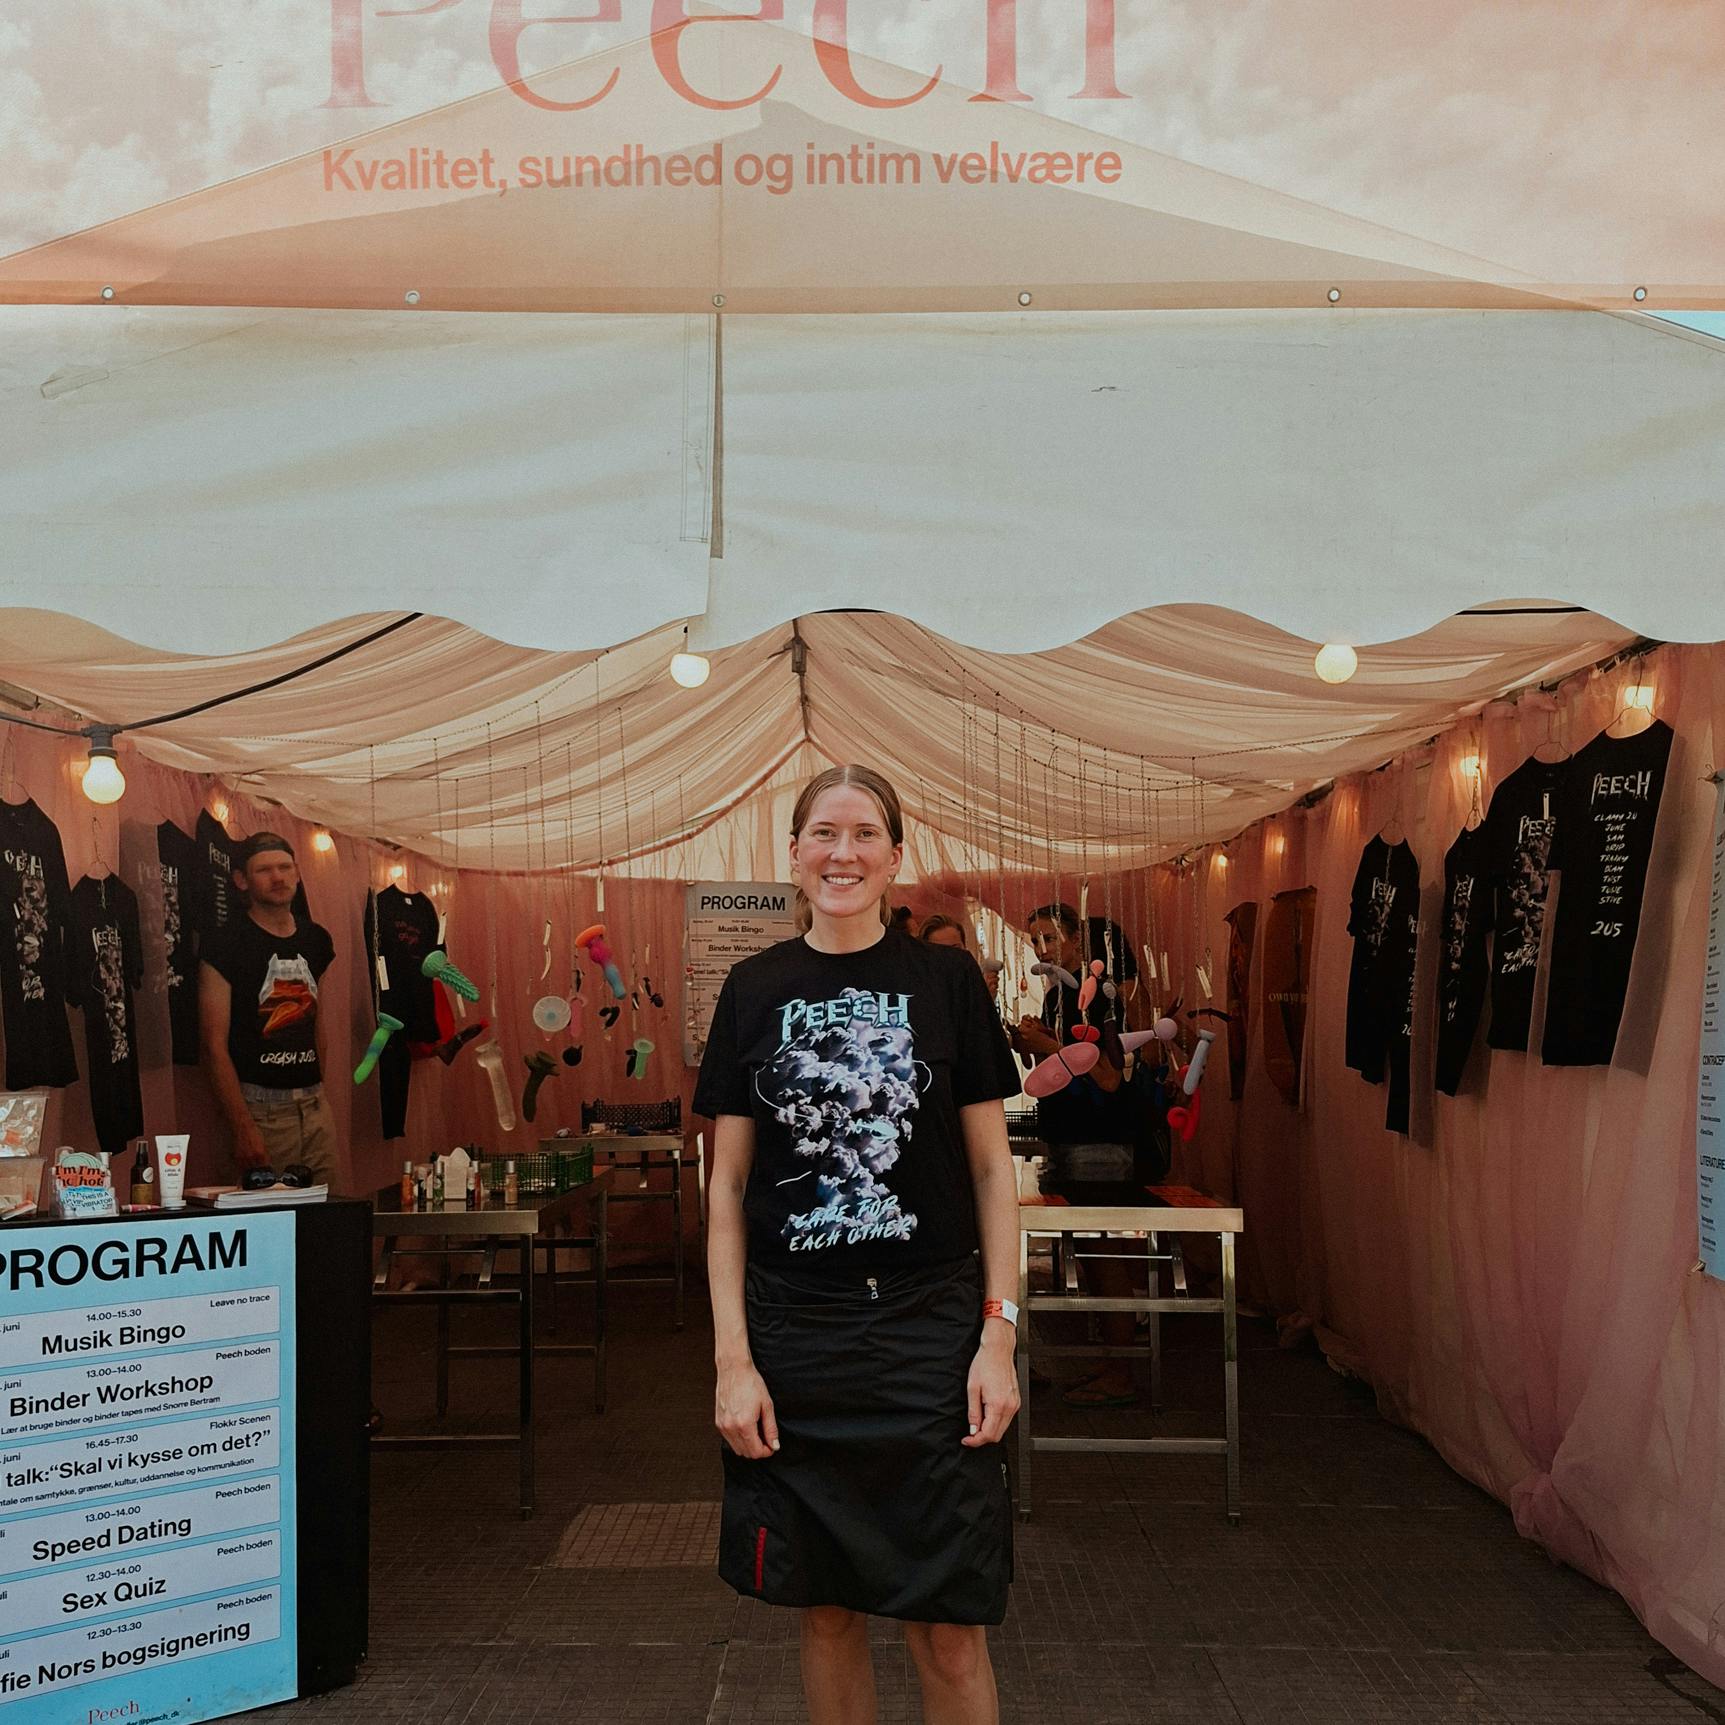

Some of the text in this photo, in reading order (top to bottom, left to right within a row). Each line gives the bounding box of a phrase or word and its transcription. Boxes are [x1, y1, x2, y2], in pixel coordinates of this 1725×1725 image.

[323, 141, 1124, 199] Kvalitet, sundhed og intim velvære
[701, 896, 786, 911] PROGRAM
[718, 926, 764, 935] Musik Bingo
[708, 944, 732, 952] Binder
[773, 991, 919, 1057] PEECH
[793, 1195, 902, 1230] CARE FOR
[789, 1215, 913, 1252] EACH OTHER
[0, 1229, 248, 1291] ROGRAM
[210, 1300, 236, 1308] Leave
[249, 1294, 271, 1303] trace
[3, 1322, 21, 1334] juni
[42, 1325, 186, 1356] Musik Bingo
[216, 1347, 271, 1361] Peech boden
[3, 1380, 22, 1391] juni
[10, 1375, 213, 1418] Binder Workshop
[1, 1427, 18, 1435] Lær
[19, 1425, 28, 1433] at
[29, 1422, 54, 1431] bruge
[55, 1417, 81, 1427] binder
[94, 1412, 119, 1421] binder
[121, 1407, 143, 1417] tapes
[144, 1405, 161, 1413] med
[190, 1396, 221, 1406] Bertram
[210, 1415, 271, 1430] Flokkr Scenen
[3, 1452, 21, 1464] juni
[107, 1454, 122, 1471] vi
[128, 1448, 183, 1468] kysse
[188, 1443, 217, 1457] om
[222, 1430, 271, 1451] det?”
[19, 1496, 33, 1504] om
[34, 1488, 77, 1501] samtykke,
[78, 1483, 114, 1494] grænser,
[114, 1478, 139, 1487] kultur,
[140, 1470, 185, 1482] uddannelse
[186, 1468, 196, 1476] og
[197, 1457, 255, 1473] kommunikation
[215, 1483, 271, 1499] Peech boden
[32, 1519, 192, 1562] Speed Dating
[217, 1539, 273, 1556] Peech boden
[62, 1577, 167, 1613] Sex Quiz
[217, 1592, 273, 1611] Peech boden
[0, 1622, 250, 1693] fie Nors bogsignering
[88, 1700, 140, 1725] Peech
